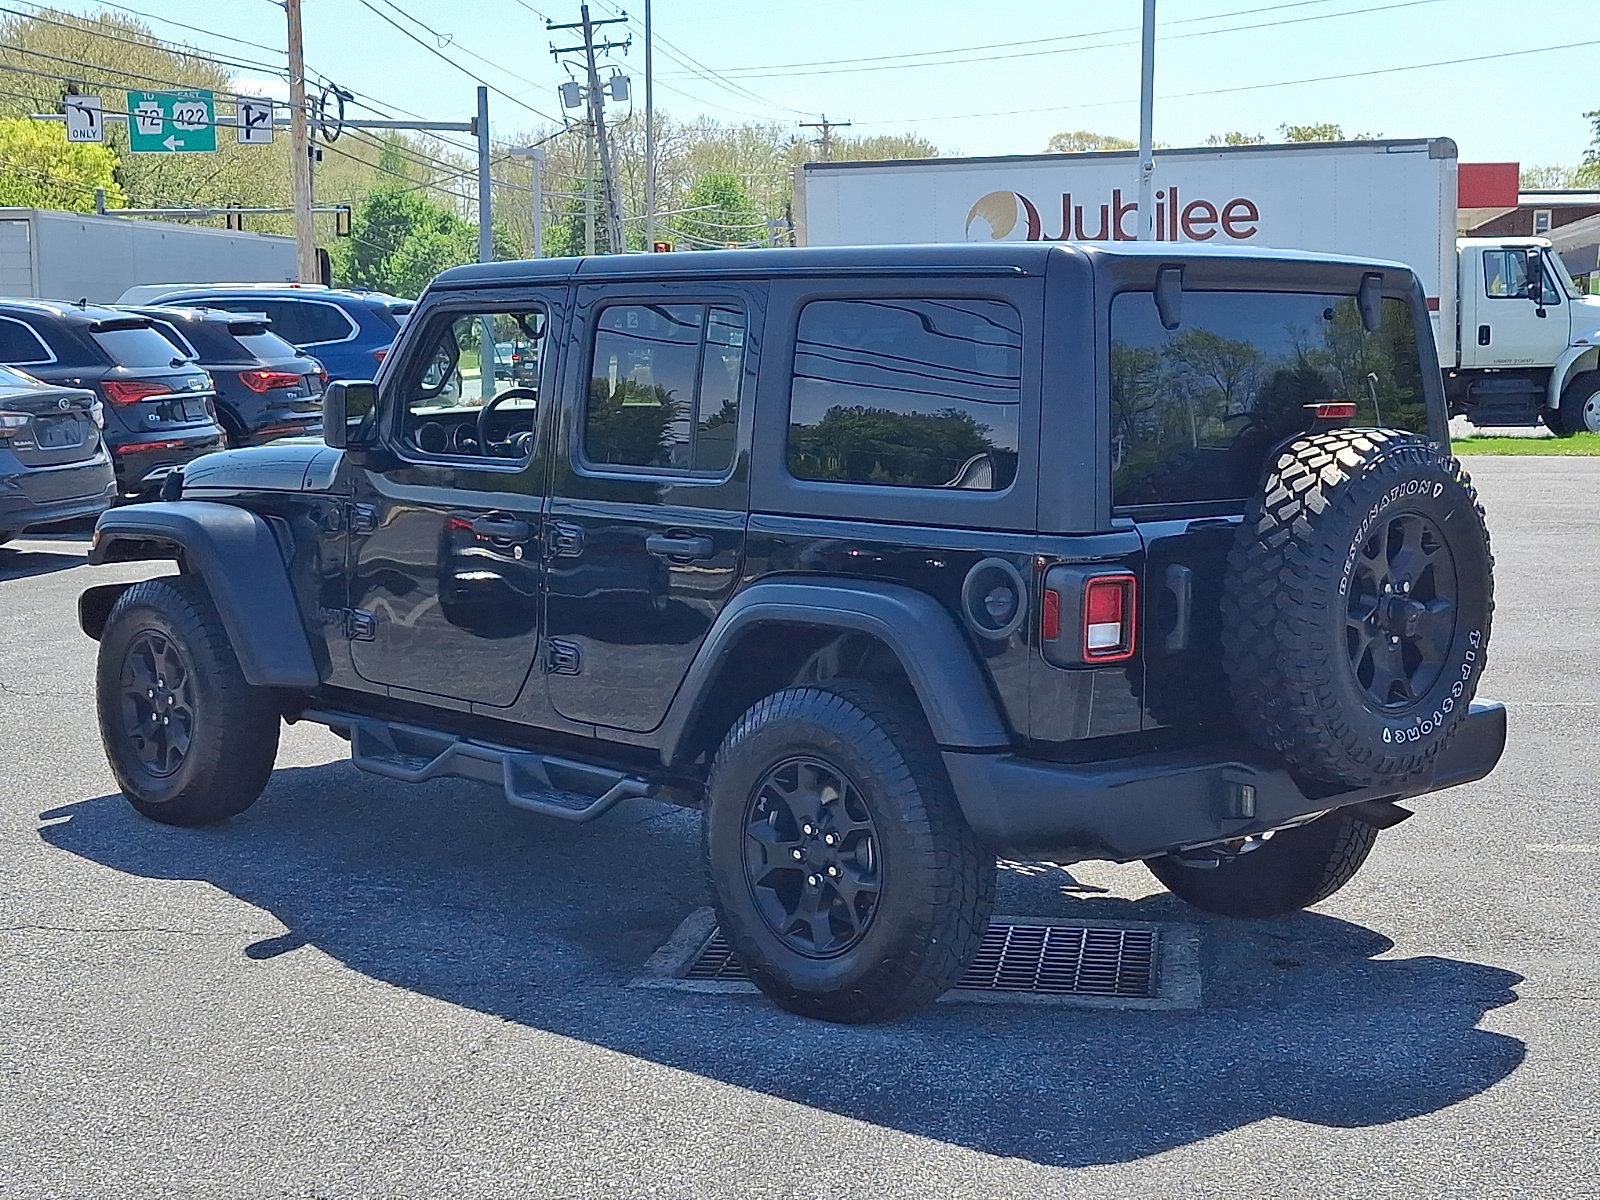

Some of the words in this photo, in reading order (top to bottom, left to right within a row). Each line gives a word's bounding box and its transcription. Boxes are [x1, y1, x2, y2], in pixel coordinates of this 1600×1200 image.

[138, 109, 161, 127] 72
[176, 108, 205, 126] 422
[72, 129, 98, 139] ONLY
[1043, 186, 1260, 242] Jubilee
[1338, 479, 1431, 596] DESTINATION
